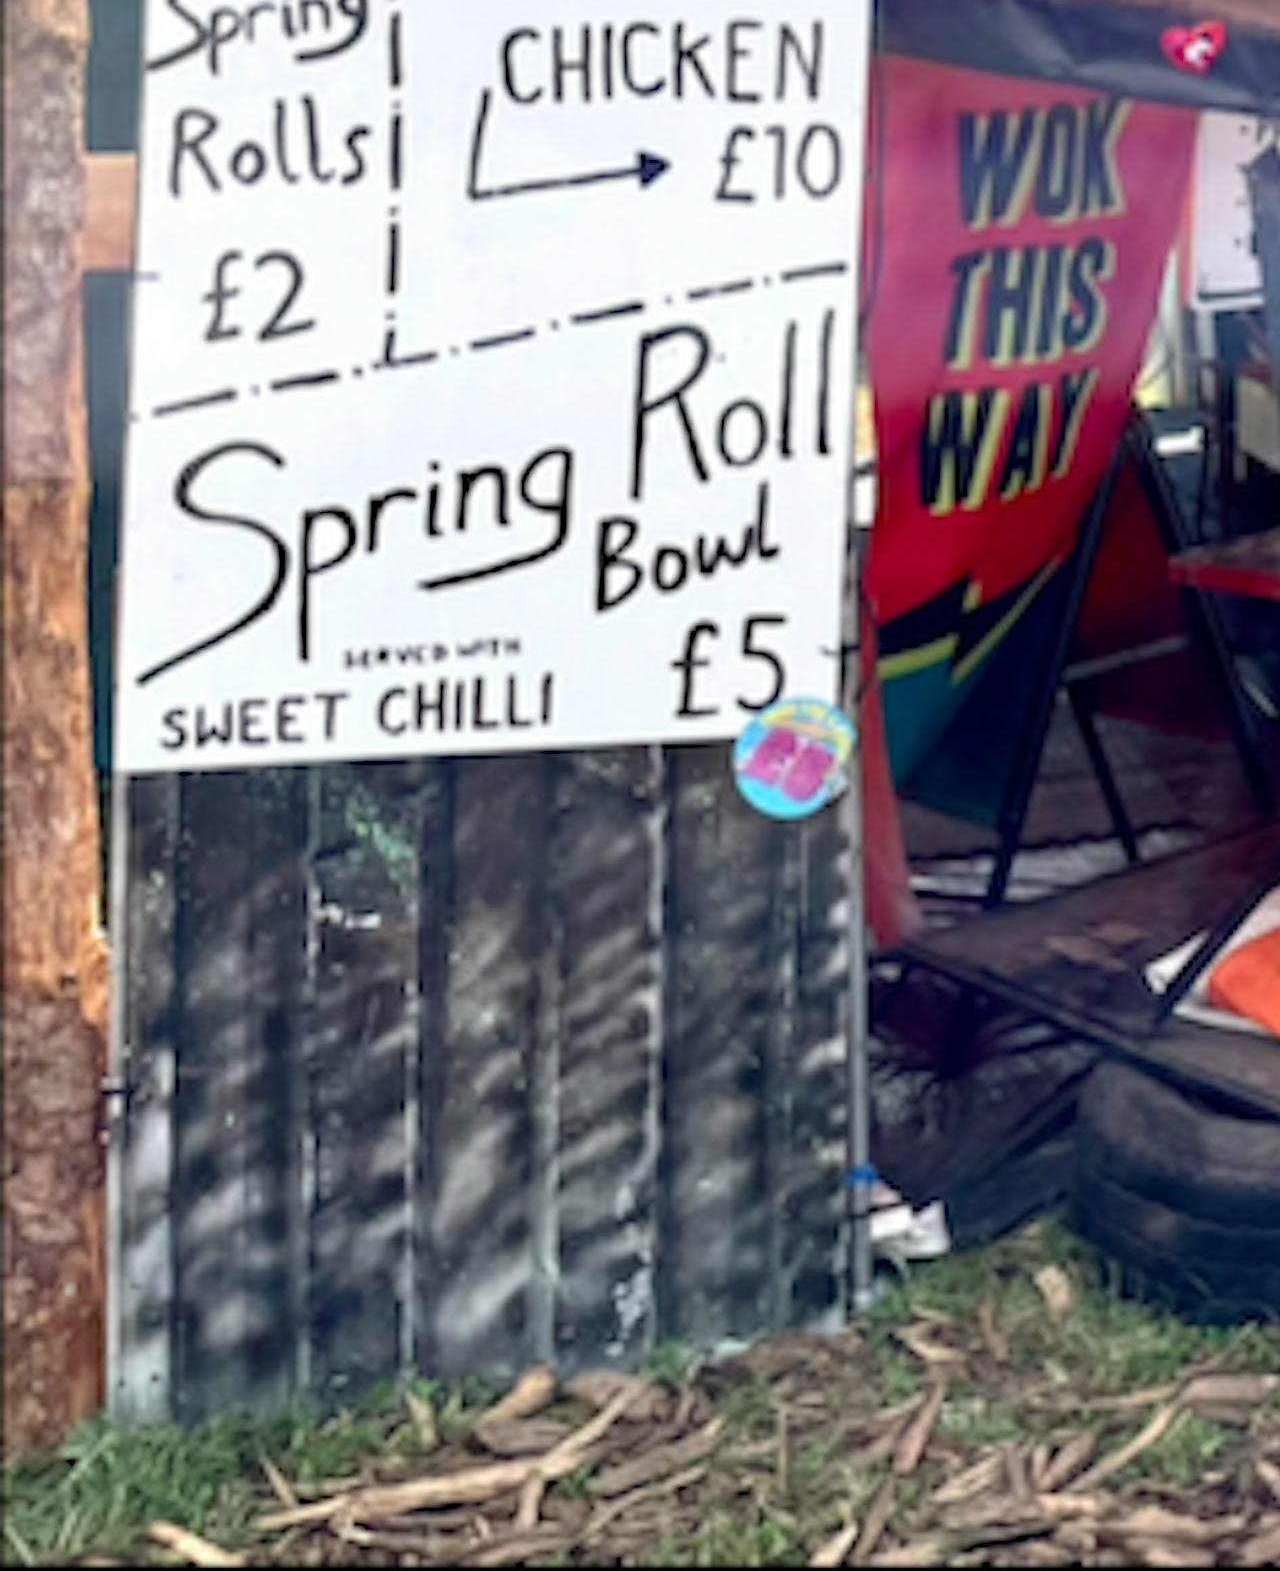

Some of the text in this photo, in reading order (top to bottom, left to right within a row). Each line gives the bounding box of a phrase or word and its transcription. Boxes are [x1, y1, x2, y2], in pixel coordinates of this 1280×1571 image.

[499, 19, 824, 108] CHICKEN
[168, 93, 371, 200] Rolls
[714, 122, 843, 204] £10
[956, 97, 1135, 231] WOK
[203, 249, 316, 344] £2
[949, 238, 1118, 373] THIS
[918, 367, 1101, 517] WAY
[137, 308, 837, 686] Spring Roll
[594, 481, 781, 615] Bowl
[159, 671, 555, 753] SWEET CHILLI
[671, 615, 790, 720] £5
